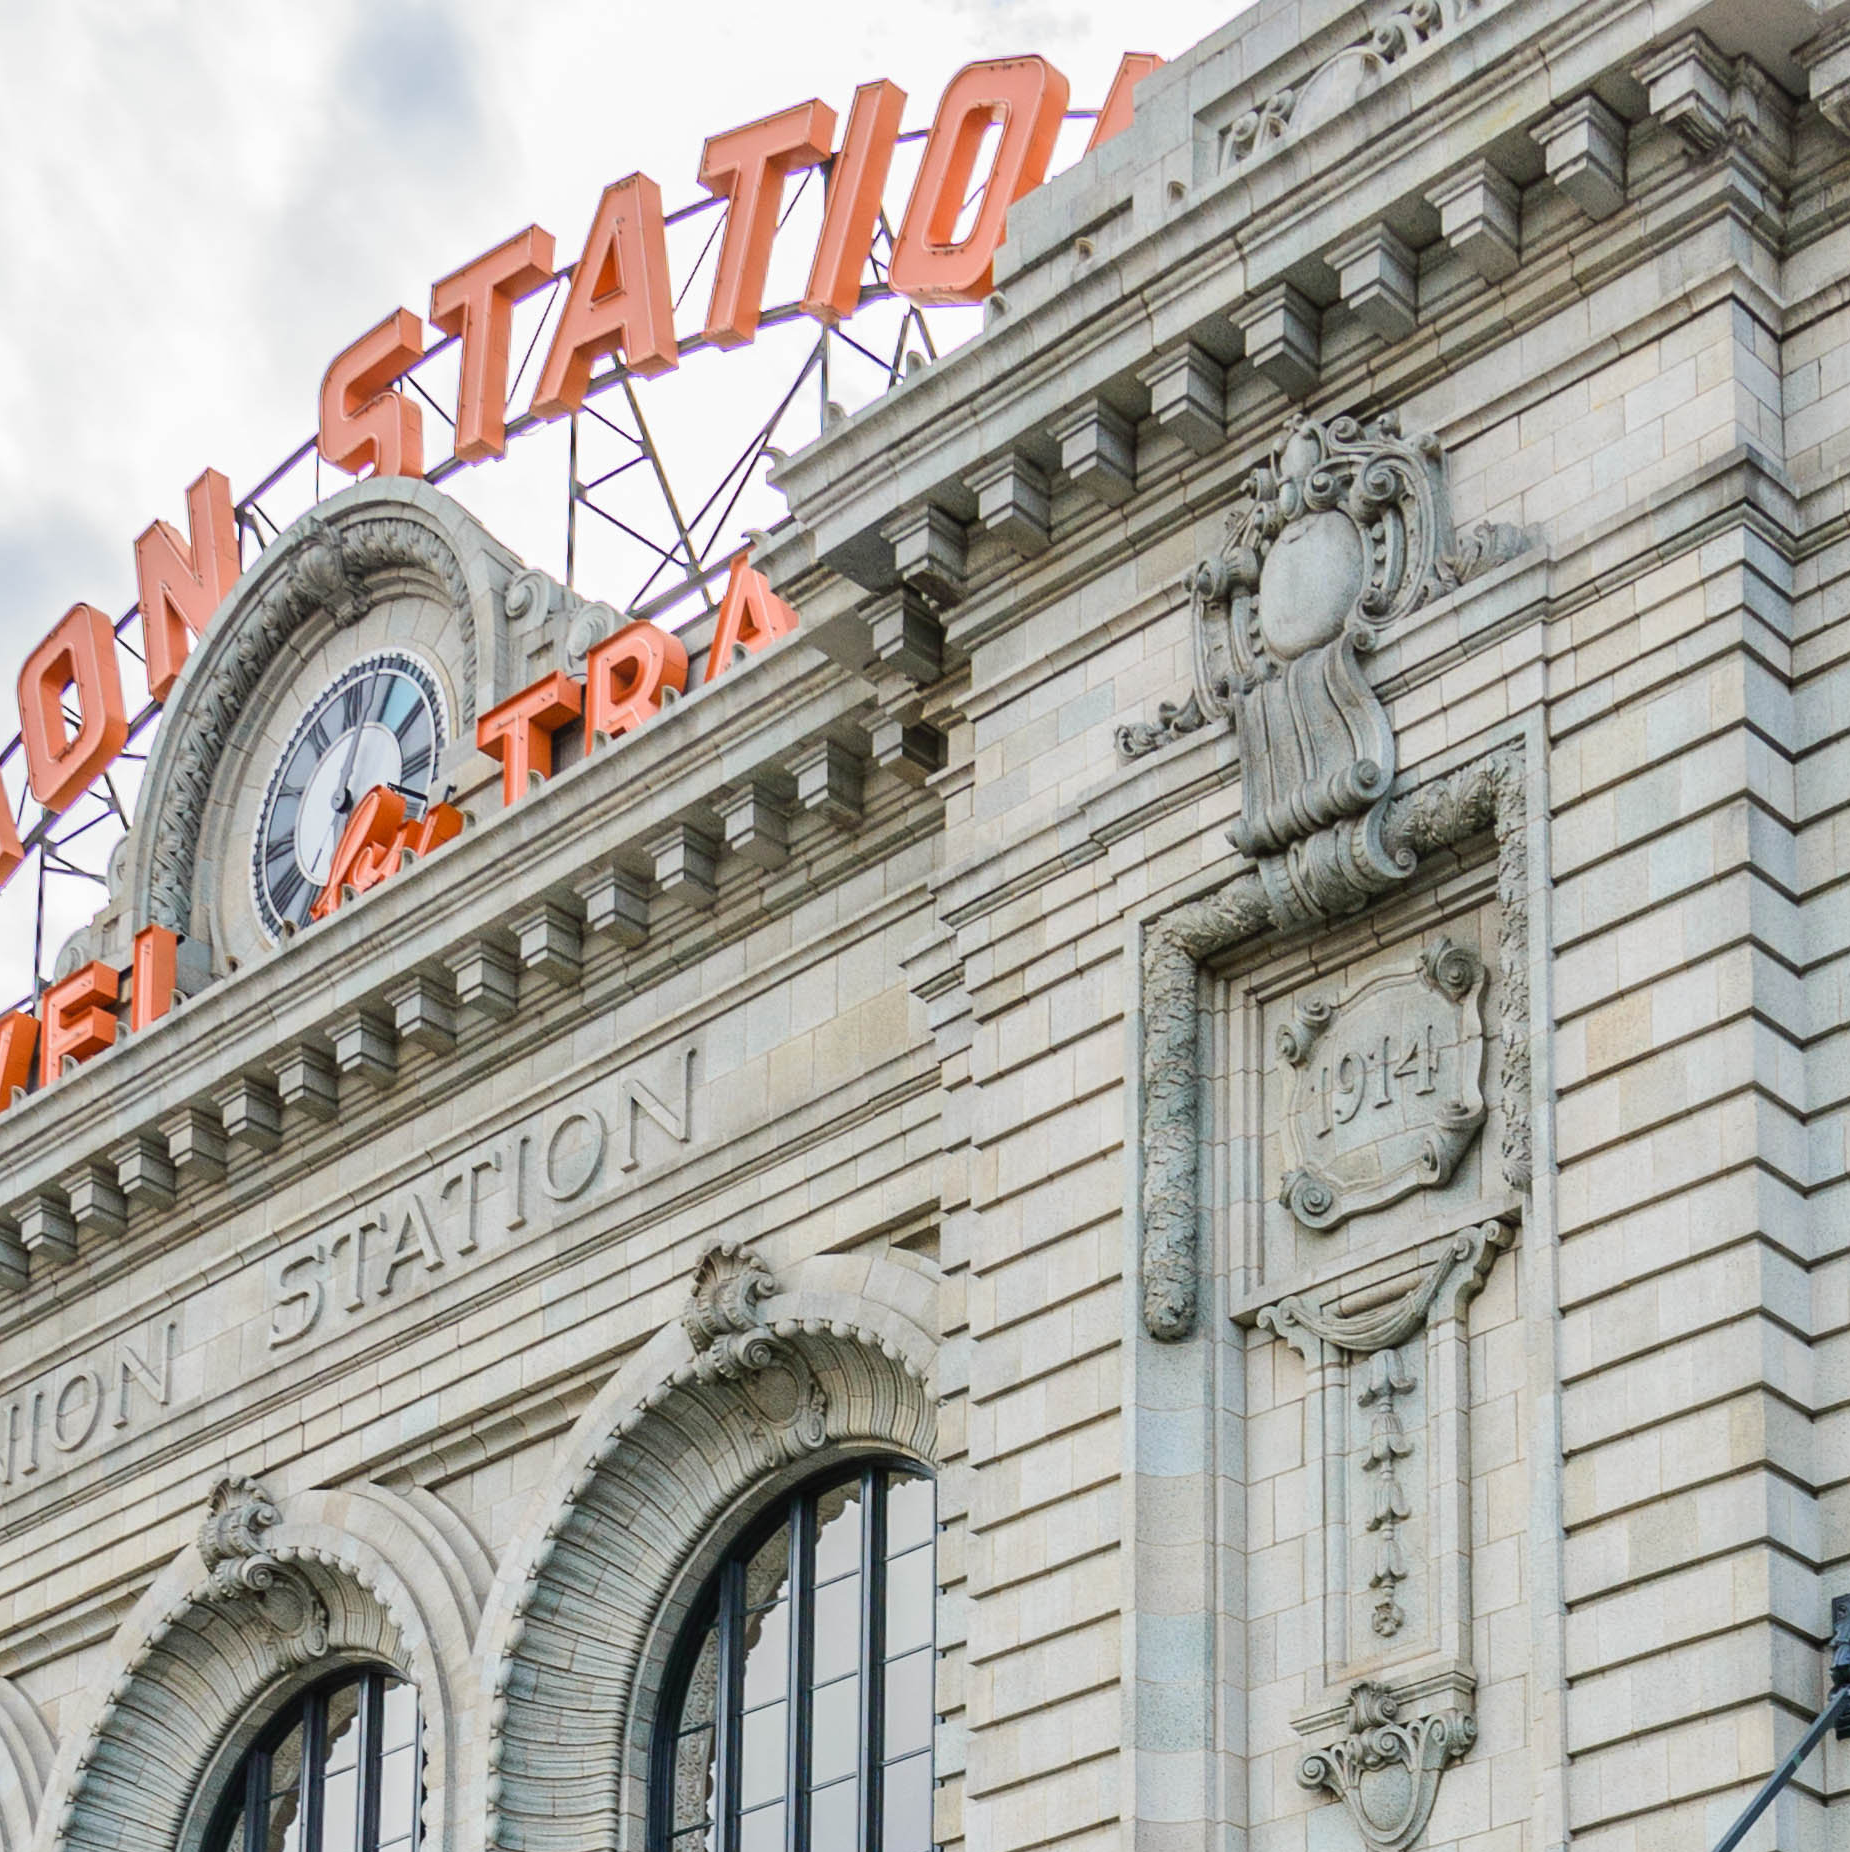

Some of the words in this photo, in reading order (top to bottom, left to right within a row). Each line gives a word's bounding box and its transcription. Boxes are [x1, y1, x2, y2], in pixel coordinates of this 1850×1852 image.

[319, 52, 1171, 479] STATIO
[267, 1046, 698, 1351] STATION
[1311, 1025, 1440, 1139] 1914
